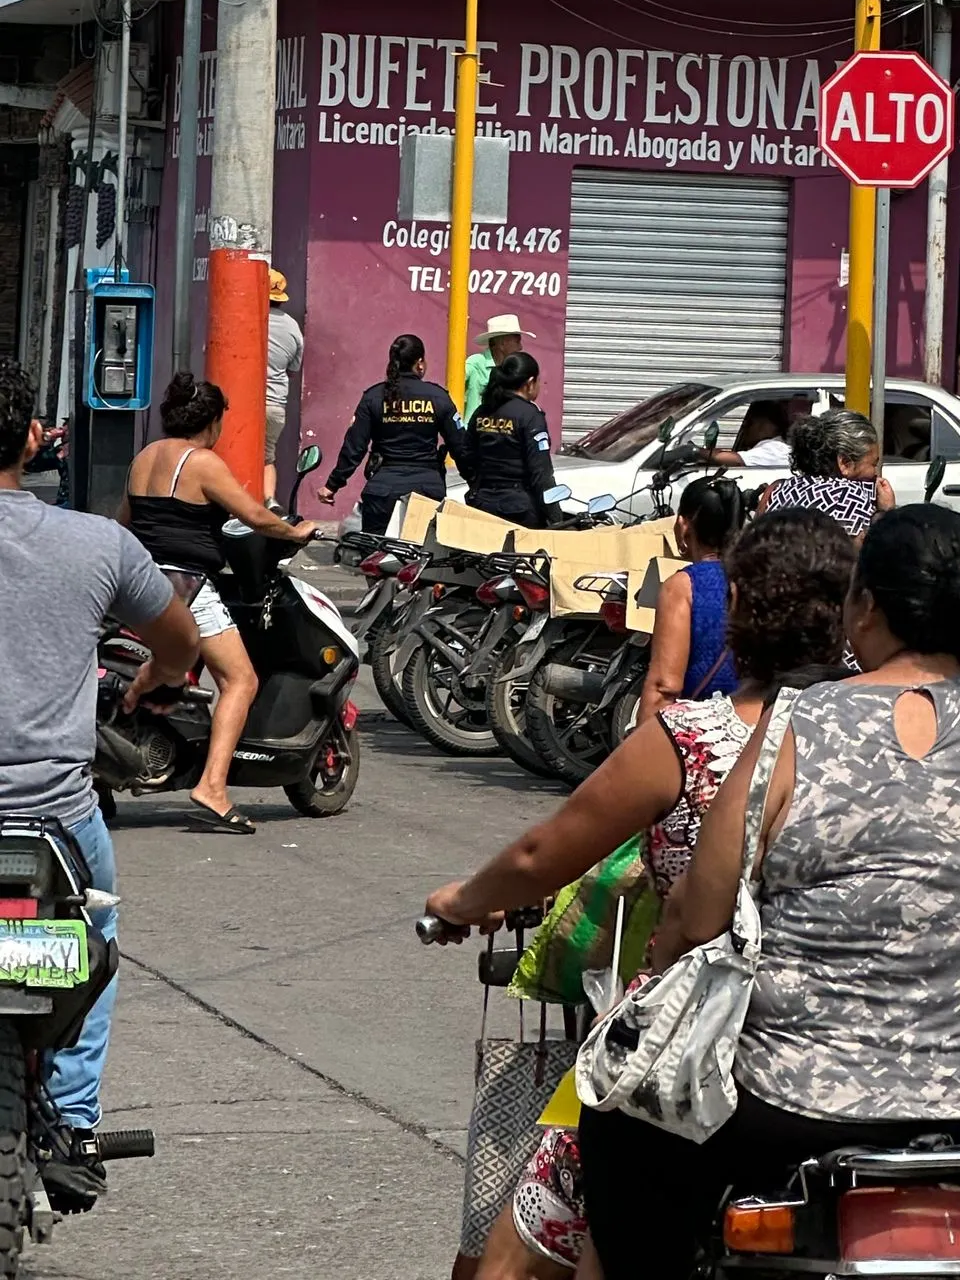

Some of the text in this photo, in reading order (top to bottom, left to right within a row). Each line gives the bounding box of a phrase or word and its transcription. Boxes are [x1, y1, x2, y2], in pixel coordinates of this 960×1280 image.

[318, 32, 498, 115] BUFETE
[516, 43, 848, 131] PROFESIONA
[831, 91, 944, 145] ALTO
[540, 123, 620, 157] Marin.
[624, 127, 721, 167] Abogada
[724, 141, 744, 170] y
[751, 134, 840, 167] Notari
[383, 221, 490, 256] Colegida
[408, 266, 451, 292] TEL:
[417, 415, 434, 423] CIVIL
